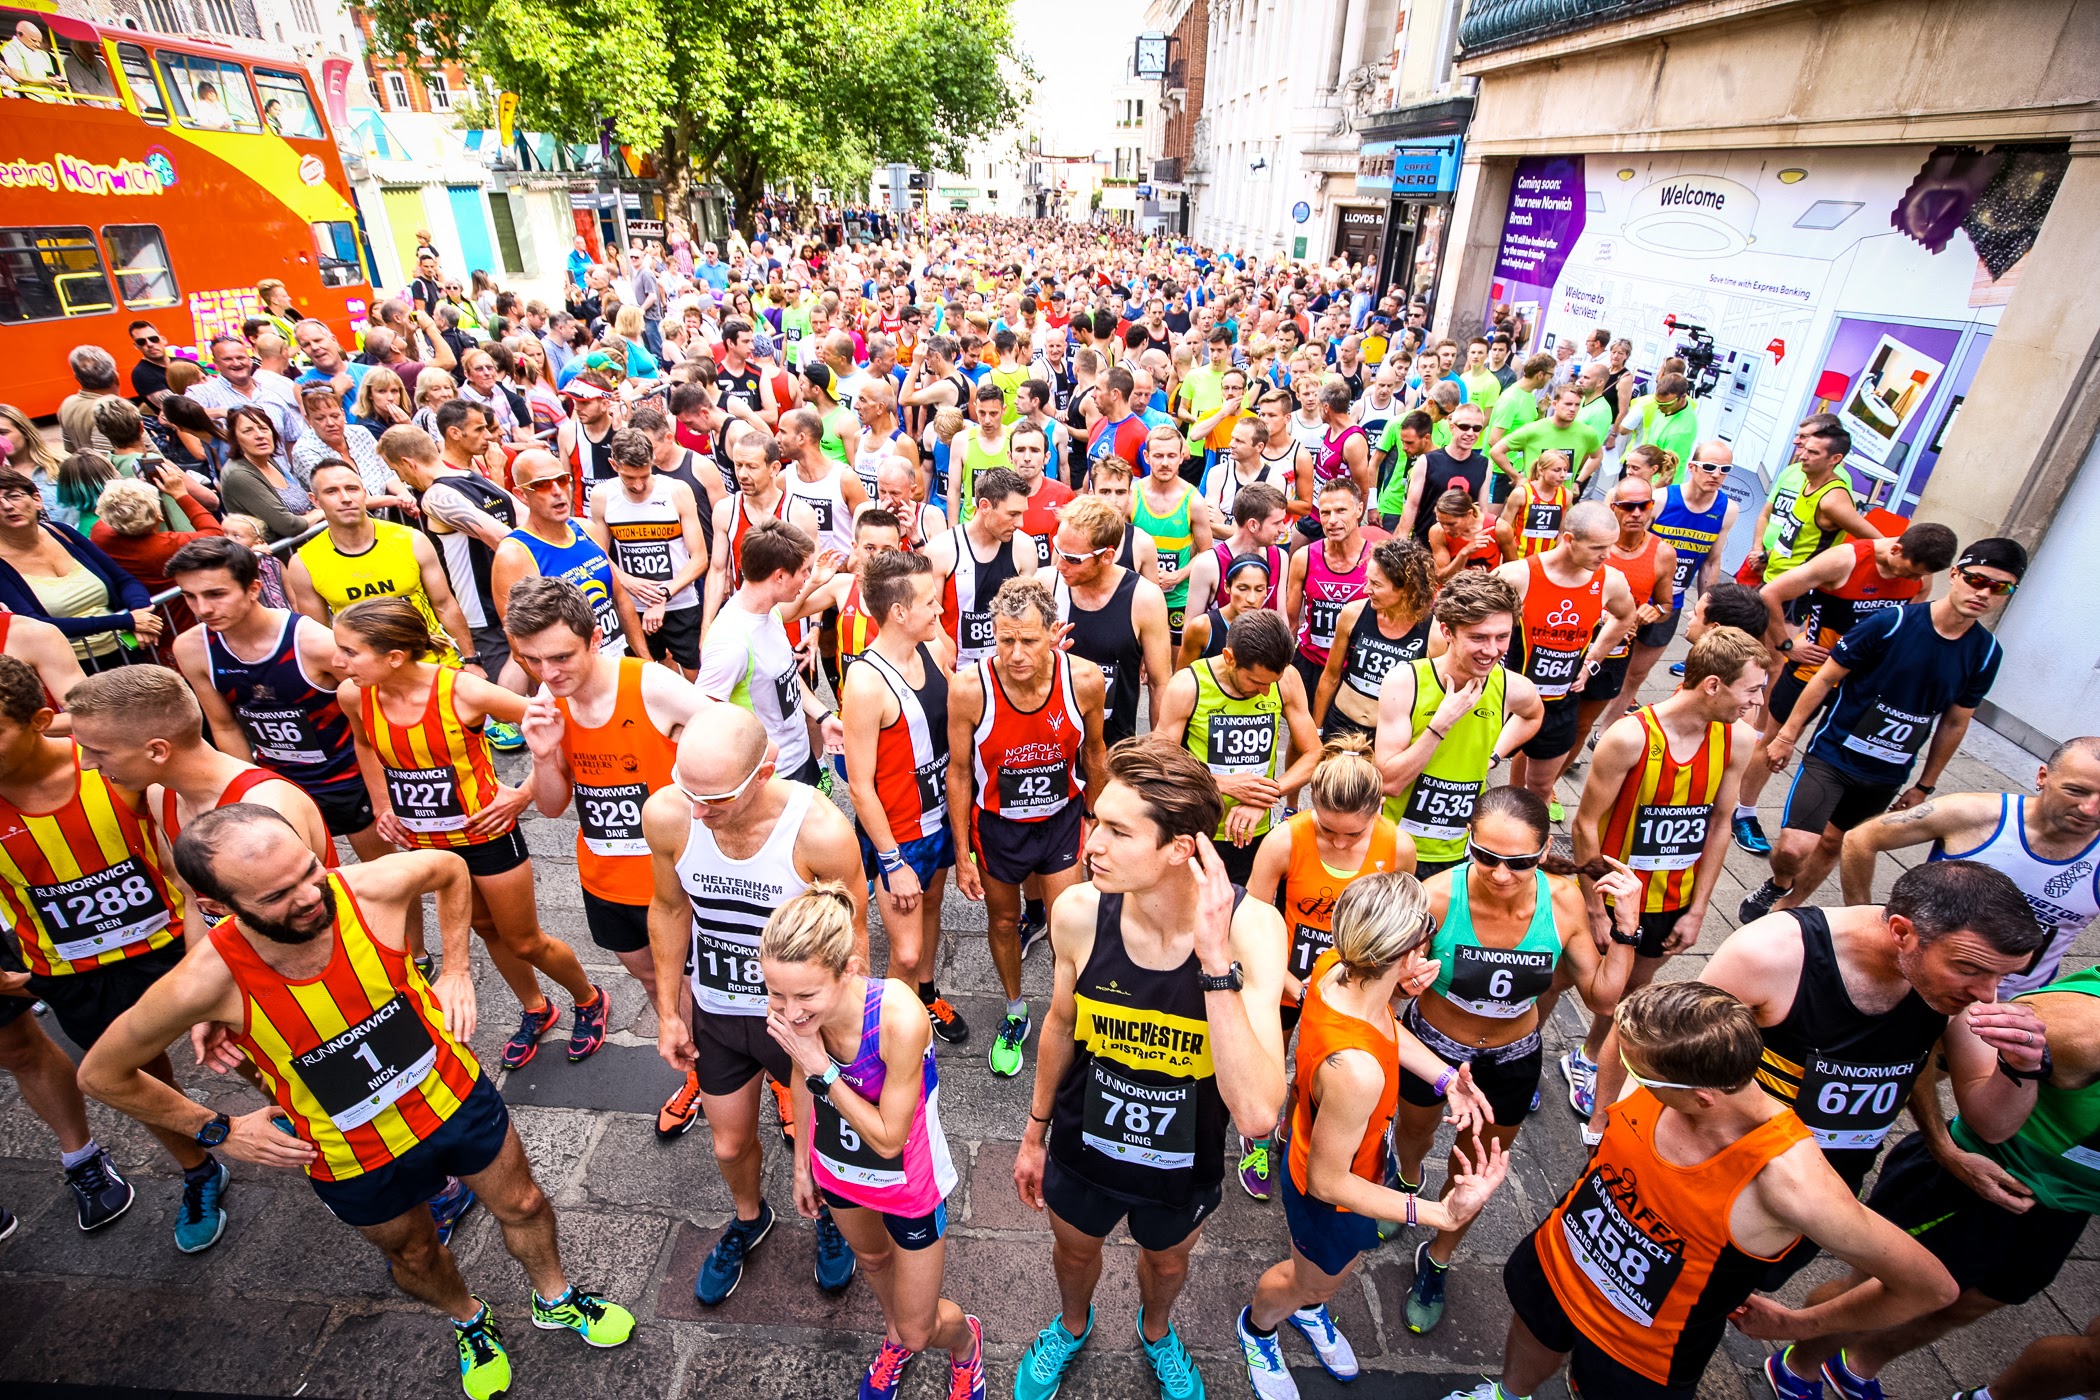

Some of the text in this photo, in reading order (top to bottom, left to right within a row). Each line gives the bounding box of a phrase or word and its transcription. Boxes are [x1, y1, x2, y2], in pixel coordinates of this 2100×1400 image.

[1396, 175, 1436, 185] NERO
[1518, 176, 1561, 193] Coming soon:
[1514, 195, 1572, 211] Your new Norwich
[1661, 183, 1725, 210] Welcome
[1345, 213, 1384, 224] LLOYDS BA
[1509, 211, 1532, 226] Branch
[1565, 286, 1604, 304] Welcome to
[1710, 274, 1810, 300] Save time with Express Banking
[1571, 304, 1597, 320] NatWest
[788, 329, 799, 338] 140
[1730, 488, 1750, 497] services
[1536, 512, 1552, 525] 21
[1662, 527, 1712, 541] LOWESTOFT
[621, 545, 665, 553] RUNNORWICH
[623, 554, 670, 574] 1302
[346, 579, 395, 601] DAN
[1314, 610, 1341, 629] 11
[1532, 626, 1588, 642] tri-anglia
[1361, 637, 1413, 659] RUNNORWICH
[1536, 648, 1580, 659] RUNNORWICH
[1535, 658, 1574, 678] 564
[239, 707, 301, 719] RUNNORWICH
[1214, 714, 1271, 727] RUNNORWICH
[1876, 702, 1929, 724] RUNNORWICH
[250, 721, 302, 742] 156
[1877, 717, 1913, 742] 70
[269, 742, 296, 750] JAMES
[1005, 742, 1061, 758] NORFOLK
[1212, 727, 1272, 755] 1399
[1866, 734, 1905, 751] LAURENCE
[574, 752, 618, 761] RHAM CITY
[1004, 751, 1062, 766] GAZELLES
[1224, 755, 1260, 765] WALFORD
[388, 767, 448, 780] RUNNORWICH
[1003, 762, 1064, 775] RUNNORWICH
[577, 785, 641, 797] RUNNORWICH
[1018, 776, 1051, 797] 42
[1422, 777, 1479, 791] RUNNORWICH
[390, 781, 452, 808] 1227
[1010, 794, 1059, 807] NIGE ARNOLD
[1415, 788, 1476, 818] 1535
[414, 809, 437, 818] RUTH
[586, 799, 641, 827] 329
[1644, 806, 1708, 816] RUNNORWICH
[1430, 816, 1449, 826] SAM
[605, 828, 629, 838] DAVE
[1640, 818, 1706, 844] 1023
[1660, 846, 1679, 854] DOM
[35, 861, 134, 898] RUNNORWICH
[692, 872, 783, 895] CHELTENHAM
[703, 883, 770, 902] HARRIERS
[41, 875, 154, 929] 1288
[94, 918, 123, 933] BEN
[703, 936, 761, 957] RUNNORW
[1462, 948, 1546, 966] RUNNORWICH
[703, 950, 764, 984] 118
[728, 982, 761, 994] ROPER
[1488, 969, 1514, 998] 6
[302, 1000, 401, 1067] RUNNORWICH
[1091, 1014, 1204, 1055] WINCHESTER
[353, 1041, 382, 1073] 1
[1110, 1043, 1166, 1060] DISTRICT
[368, 1064, 398, 1091] NICK
[1815, 1060, 1914, 1078] RUNNORWICH
[1095, 1068, 1186, 1101] RUNNORWICH
[1817, 1081, 1899, 1115] 670
[1101, 1090, 1177, 1136] 787
[839, 1117, 861, 1152] 5
[1122, 1132, 1152, 1146] KING
[1592, 1175, 1671, 1265] RUNNORWICH
[1581, 1207, 1650, 1286] 458
[1565, 1213, 1592, 1252] CRAIG
[1592, 1250, 1652, 1311] FIDDAMAN
